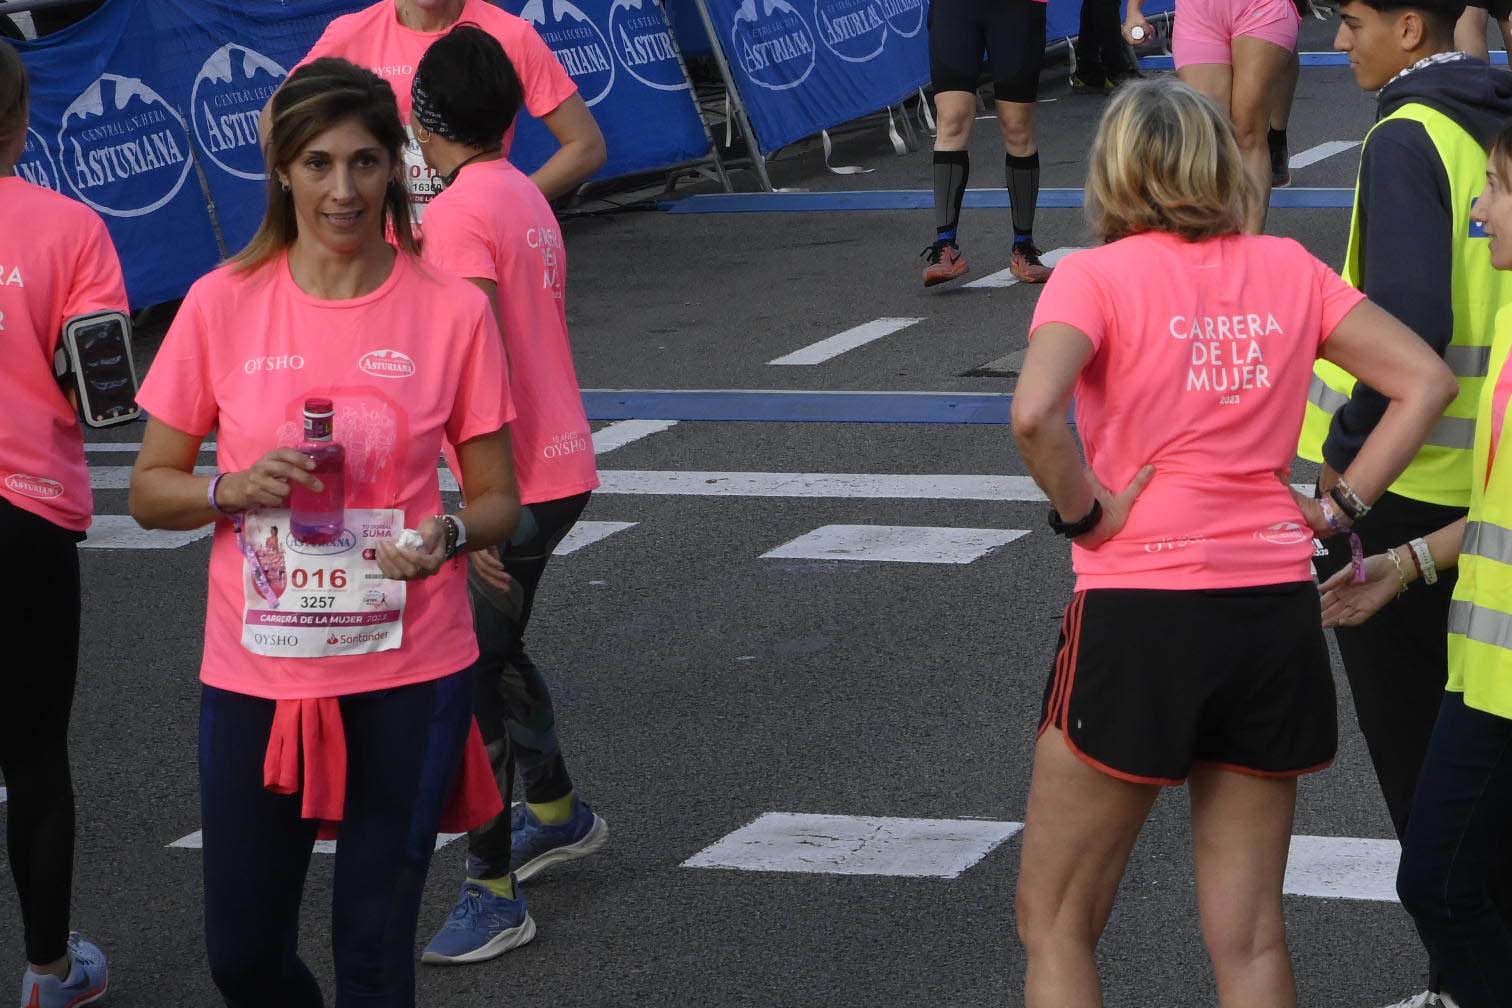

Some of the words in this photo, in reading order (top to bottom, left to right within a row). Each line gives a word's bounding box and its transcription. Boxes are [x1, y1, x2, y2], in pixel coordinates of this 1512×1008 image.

[1169, 312, 1285, 340] CARRERA
[1192, 341, 1222, 365] DE
[1231, 340, 1263, 365] LA
[245, 354, 304, 375] OYSHO
[364, 359, 412, 374] ASTURIANA
[1186, 364, 1272, 391] MUJER
[544, 438, 586, 459] OYSHO
[362, 529, 392, 538] SUMA
[291, 568, 347, 589] 016
[300, 596, 335, 609] 3257
[260, 614, 298, 624] CARRERA
[300, 615, 313, 624] DE
[315, 615, 328, 624] LA
[329, 615, 362, 624] MUJER
[255, 633, 298, 647] OYSHO
[340, 631, 389, 644] Santander
